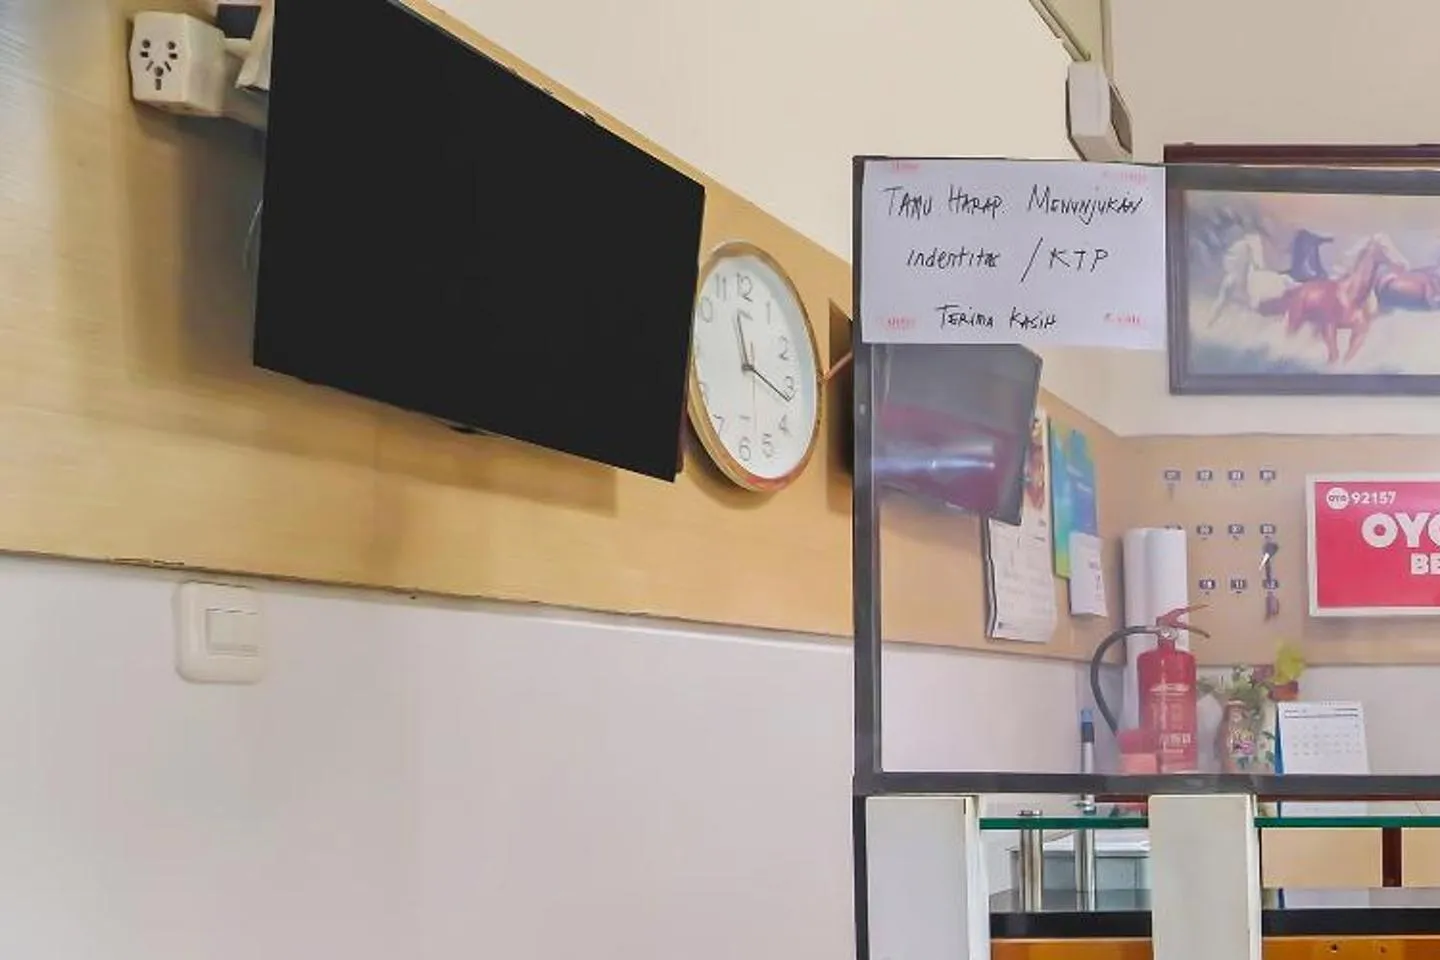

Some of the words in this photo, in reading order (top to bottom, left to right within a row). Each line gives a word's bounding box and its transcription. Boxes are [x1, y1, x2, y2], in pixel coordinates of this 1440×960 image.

[737, 271, 754, 302] 12
[778, 335, 789, 361] 2
[738, 436, 752, 461] 6
[1350, 490, 1397, 505] 92157
